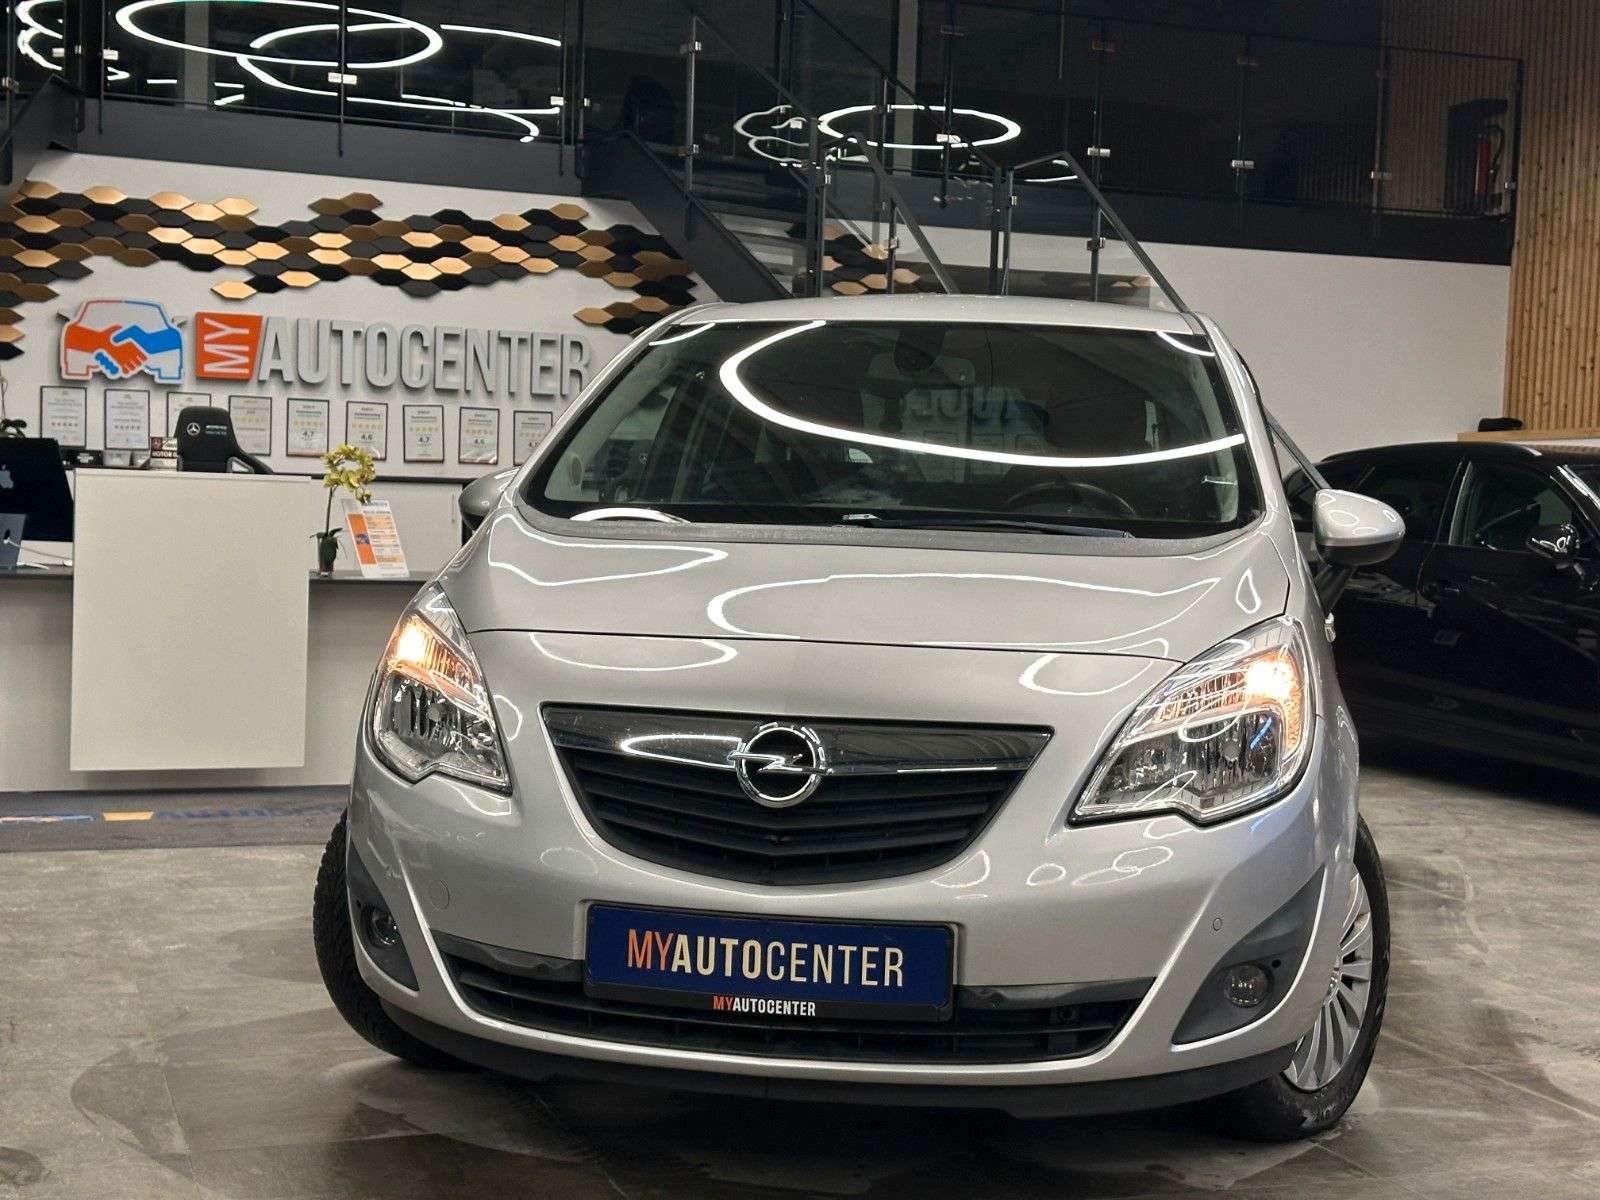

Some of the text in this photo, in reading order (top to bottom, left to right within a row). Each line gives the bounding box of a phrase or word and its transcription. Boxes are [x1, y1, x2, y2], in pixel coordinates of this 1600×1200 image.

[203, 316, 591, 397] MY AUTOCENTER
[627, 928, 905, 987] MYAUTOCENTER
[713, 995, 816, 1017] MYAUTOCENTER
